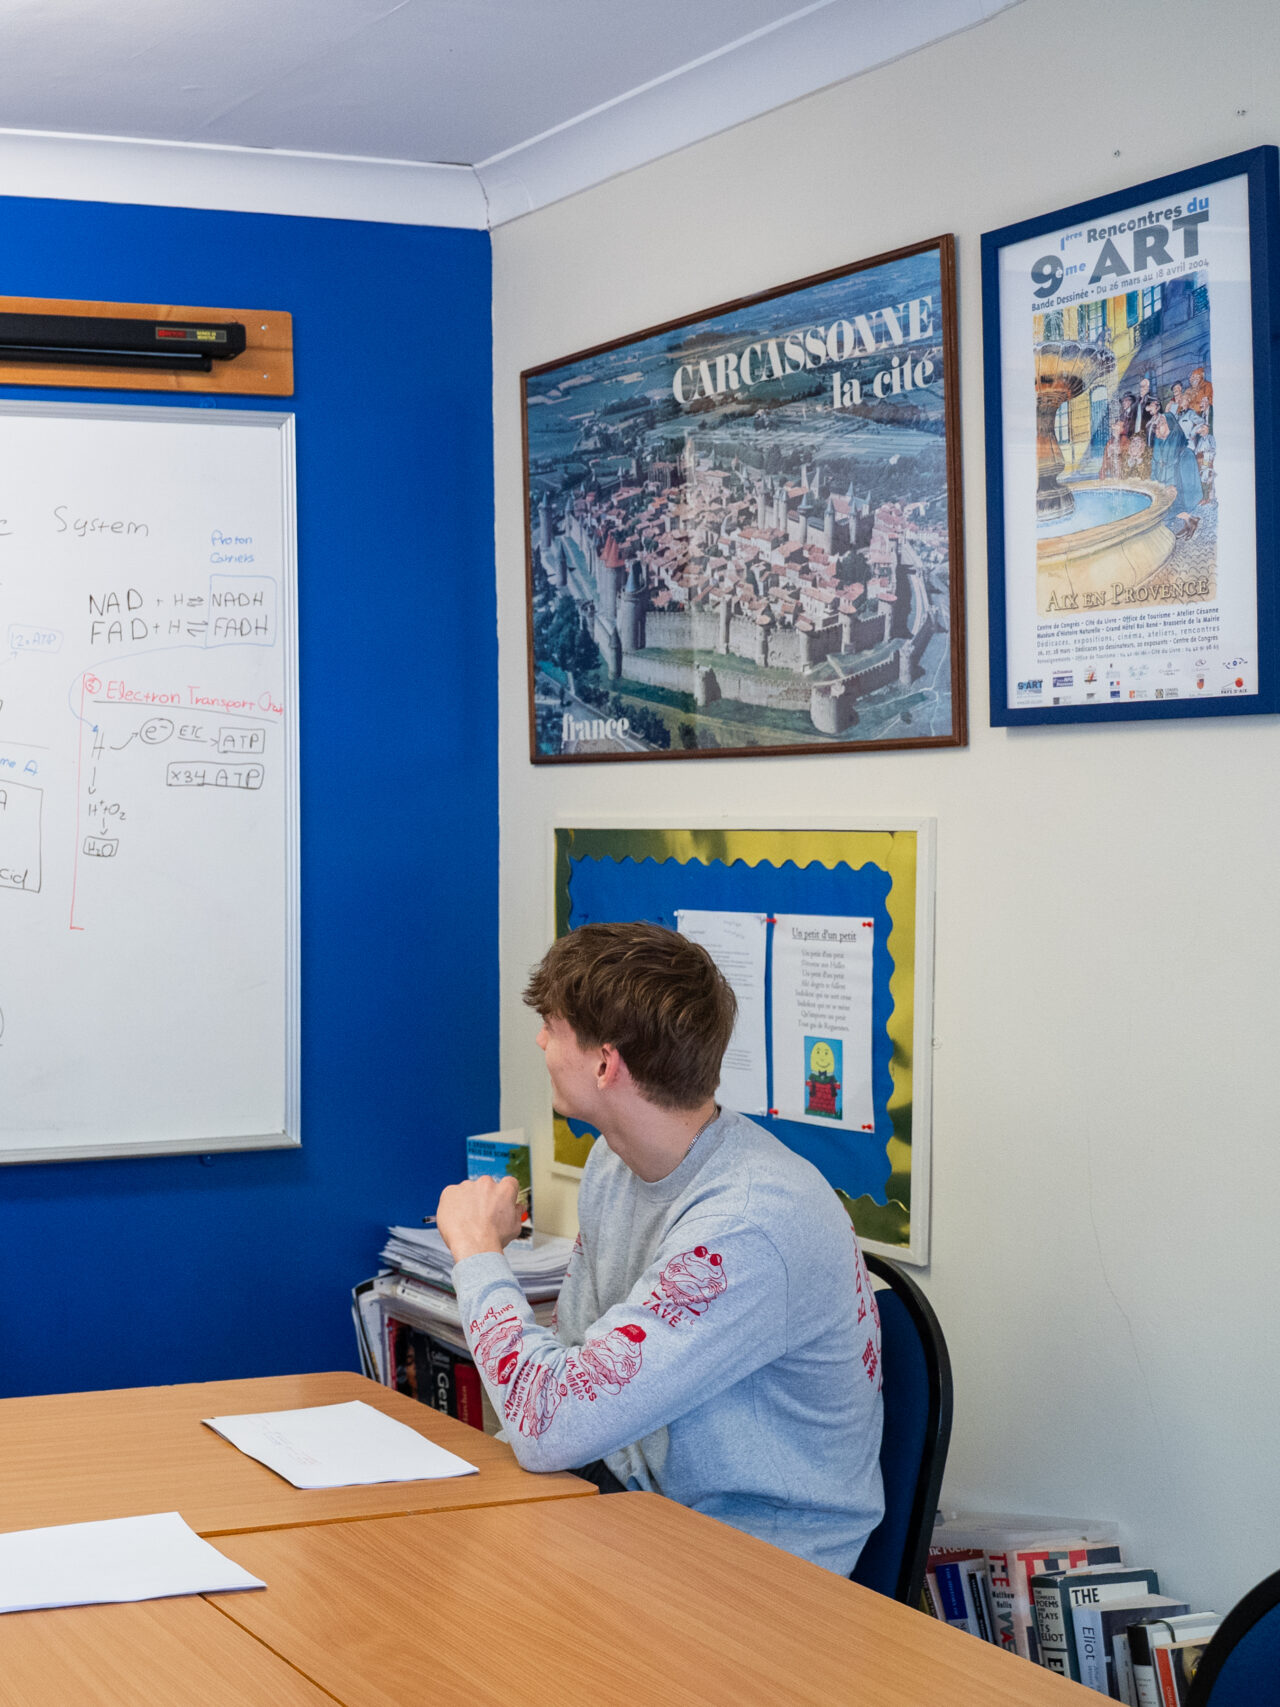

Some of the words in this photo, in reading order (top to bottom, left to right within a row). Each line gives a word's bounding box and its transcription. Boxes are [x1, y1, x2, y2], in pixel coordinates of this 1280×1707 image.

[1087, 205, 1182, 243] Rencontres
[1187, 197, 1209, 213] du
[1088, 209, 1209, 285] ART
[1032, 300, 1054, 312] Bande
[1056, 289, 1089, 304] Dessinée
[1096, 285, 1107, 295] Du
[1109, 282, 1119, 291] 26
[1121, 276, 1140, 287] mars
[1143, 274, 1153, 282] au
[1166, 261, 1186, 276] avril
[1188, 257, 1210, 271] 2004
[672, 294, 935, 404] CARCASSONNE
[832, 371, 863, 409] la
[873, 349, 935, 394] cité
[53, 504, 150, 538] System
[88, 588, 144, 616] NAD
[173, 592, 184, 606] H
[212, 591, 264, 607] NADH
[90, 617, 149, 645] FAD
[168, 619, 181, 635] H
[213, 614, 269, 638] FADH
[106, 680, 181, 705] Electron
[187, 685, 256, 715] Transport
[223, 733, 260, 749] ATP
[561, 712, 630, 743] france
[216, 768, 261, 788] ATP
[792, 927, 802, 940] Un
[804, 929, 820, 941] petit
[821, 928, 838, 939] d'un
[839, 930, 857, 944] petit
[575, 1371, 598, 1402] BASS
[1036, 1600, 1059, 1608] POEMS
[1071, 1587, 1100, 1605] THE
[1039, 1612, 1059, 1621] PLAYS
[1041, 1633, 1064, 1642] ELIOT
[1082, 1626, 1096, 1661] Eliot
